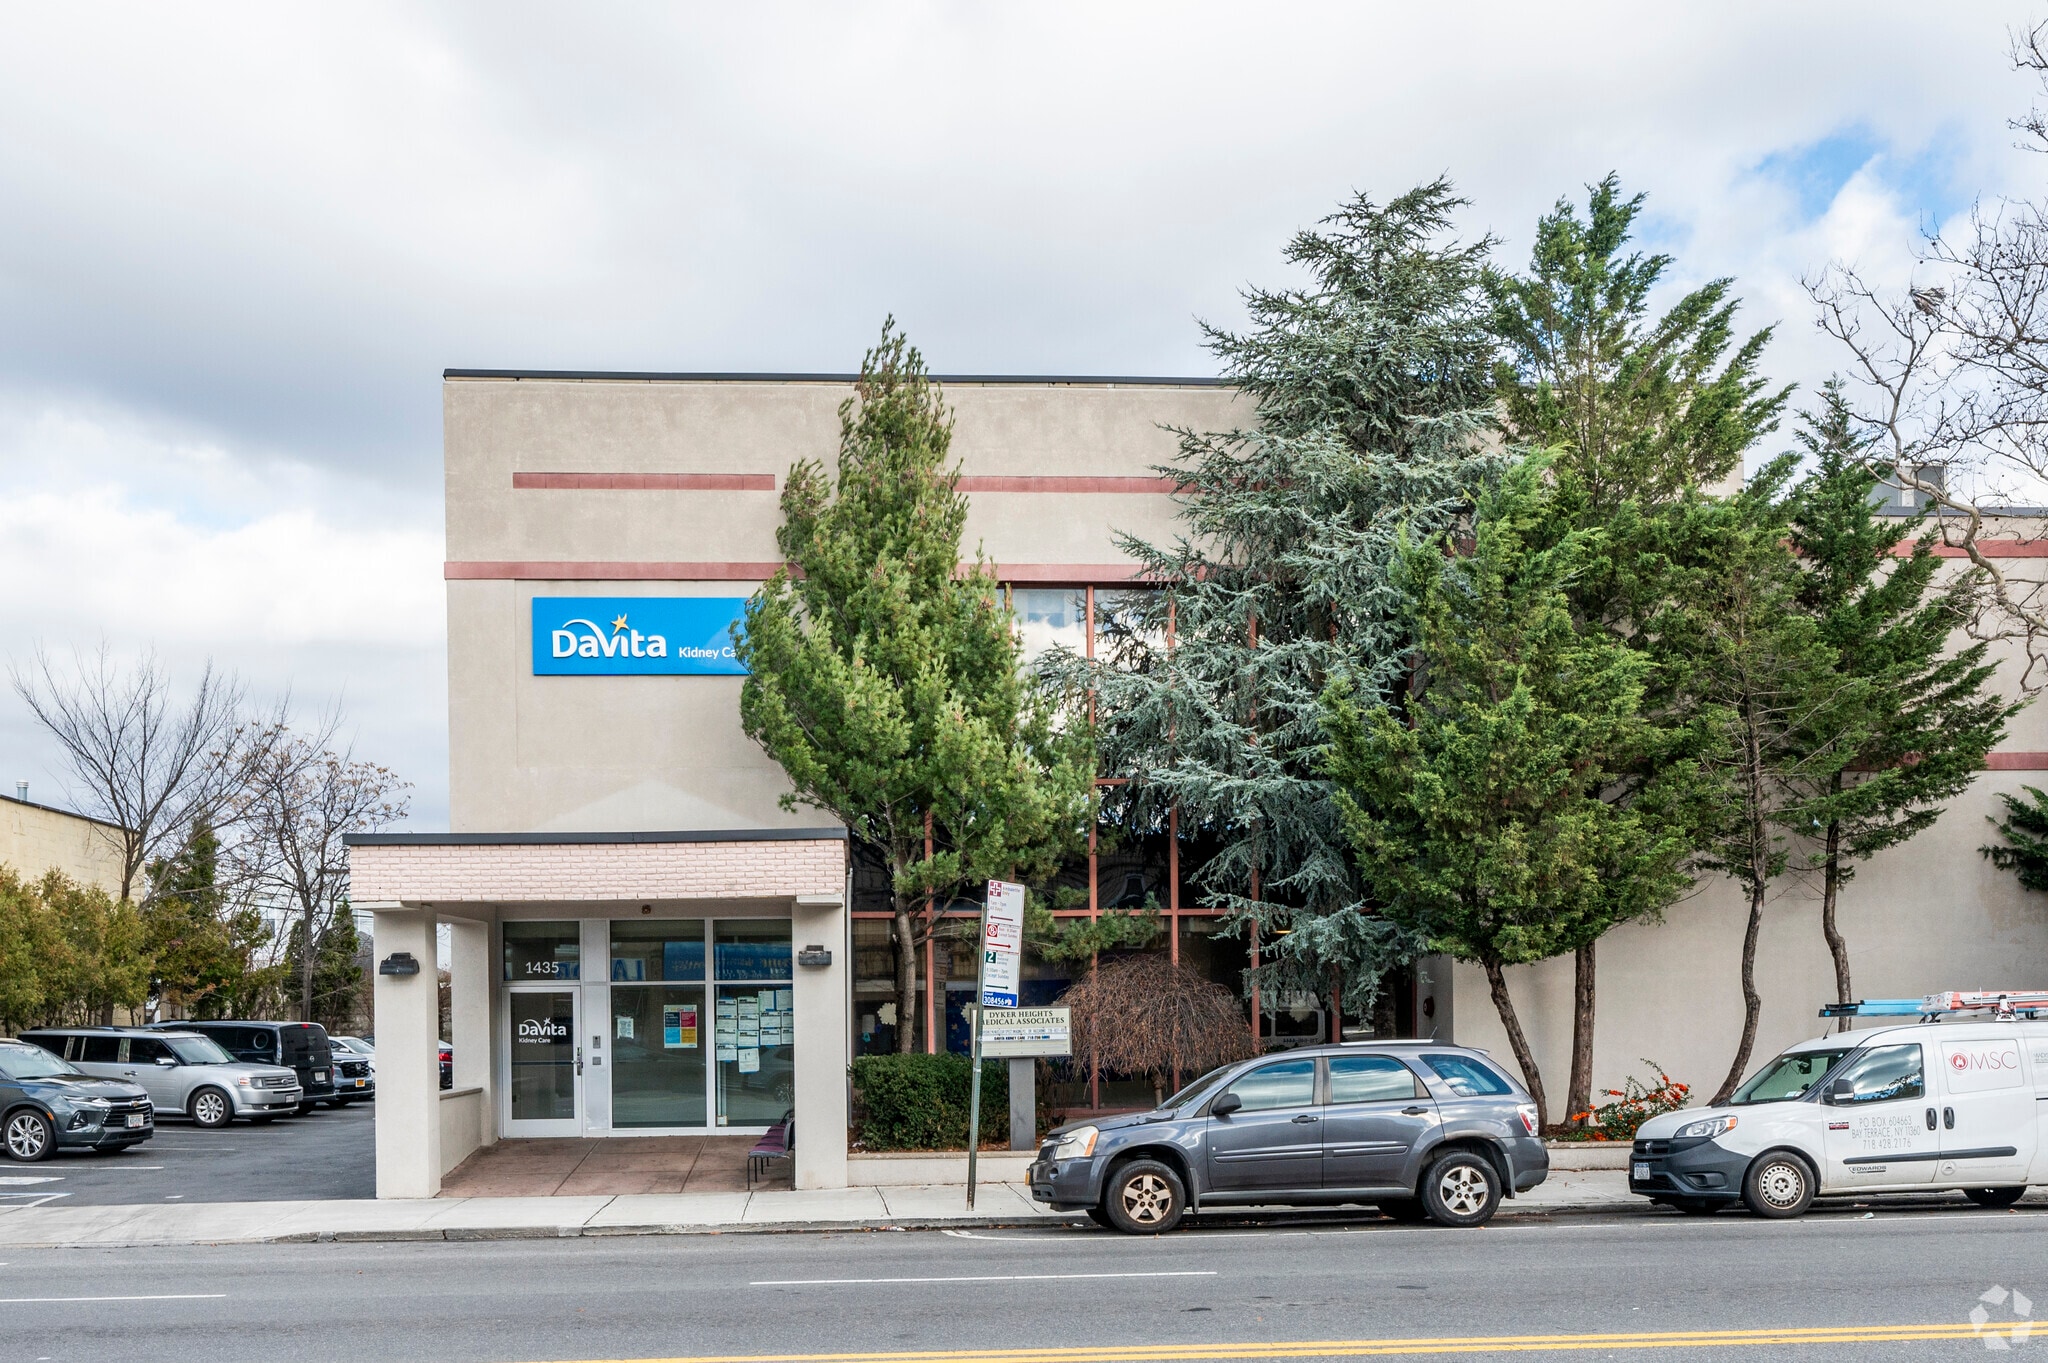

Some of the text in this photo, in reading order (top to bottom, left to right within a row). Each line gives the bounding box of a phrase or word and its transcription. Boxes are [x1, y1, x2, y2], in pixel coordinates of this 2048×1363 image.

[552, 618, 737, 660] DaVita Kidney Ca
[987, 951, 994, 962] 2
[525, 961, 560, 974] 1435
[1018, 1010, 1053, 1018] HEIGHTS
[518, 1017, 567, 1036] DaVita
[1016, 1017, 1065, 1025] ASSOCIATES
[1970, 1050, 2017, 1070] MSC
[1858, 1117, 1869, 1127] PO
[1871, 1116, 1886, 1126] BOX
[1888, 1115, 1912, 1126] 604663
[1851, 1125, 1921, 1139] BAY TERRACE, NY 11360
[1863, 1138, 1912, 1149] 718.428.2176
